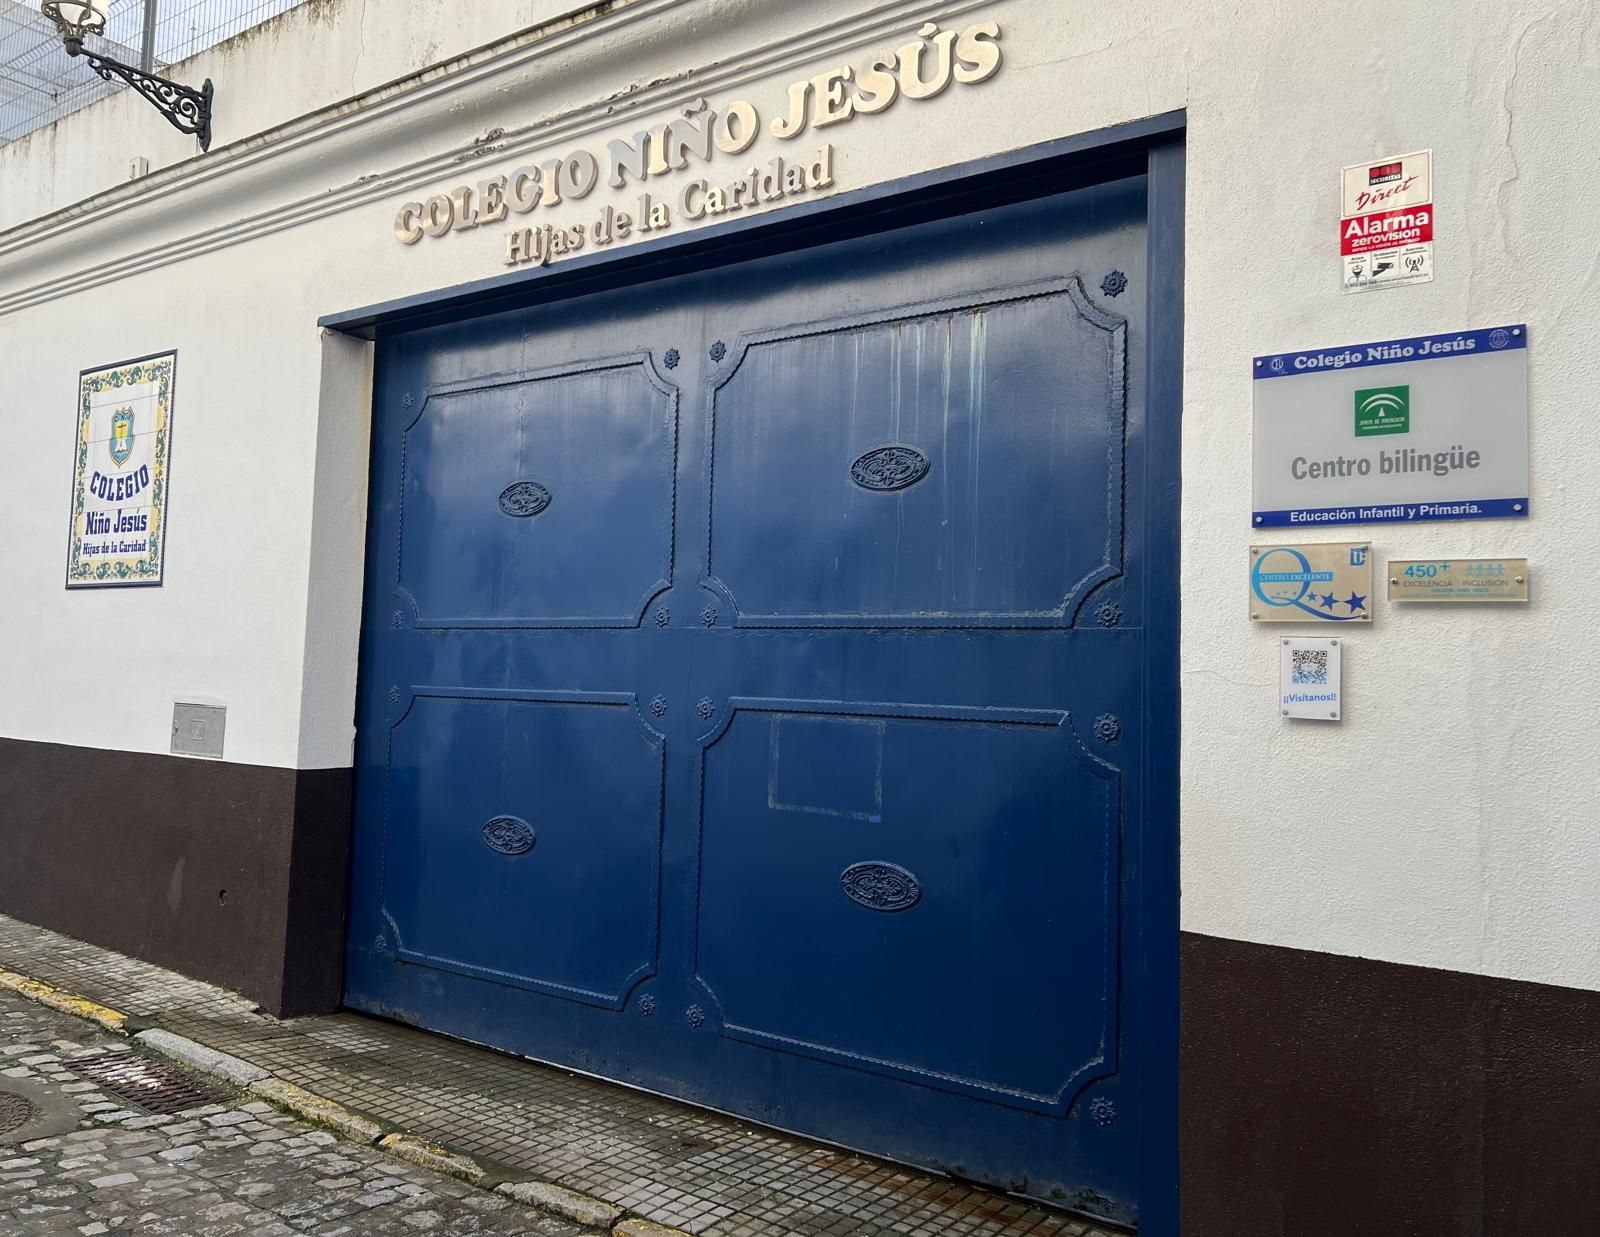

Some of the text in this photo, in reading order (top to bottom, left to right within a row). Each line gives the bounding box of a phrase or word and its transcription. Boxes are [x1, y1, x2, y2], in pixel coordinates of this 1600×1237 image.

[394, 21, 1003, 245] COLEGIO NIÑO JESÚS
[1355, 176, 1419, 211] Direct
[1370, 174, 1402, 184] SECURITAS
[502, 143, 834, 267] Hijas de la Caridad
[1344, 211, 1429, 239] Alarma
[1294, 350, 1362, 370] Colegio
[1367, 343, 1414, 362] Niño
[1418, 335, 1476, 355] Jesús
[1291, 445, 1481, 480] Centro bilingüe
[89, 464, 150, 502] COLEGIO
[85, 508, 147, 536] Niño Jesús
[1290, 502, 1483, 523] Educación Infantil y Primaria.
[82, 539, 147, 557] Hijas de la Caridad
[1260, 573, 1332, 581] CENTRO EXCELENTE
